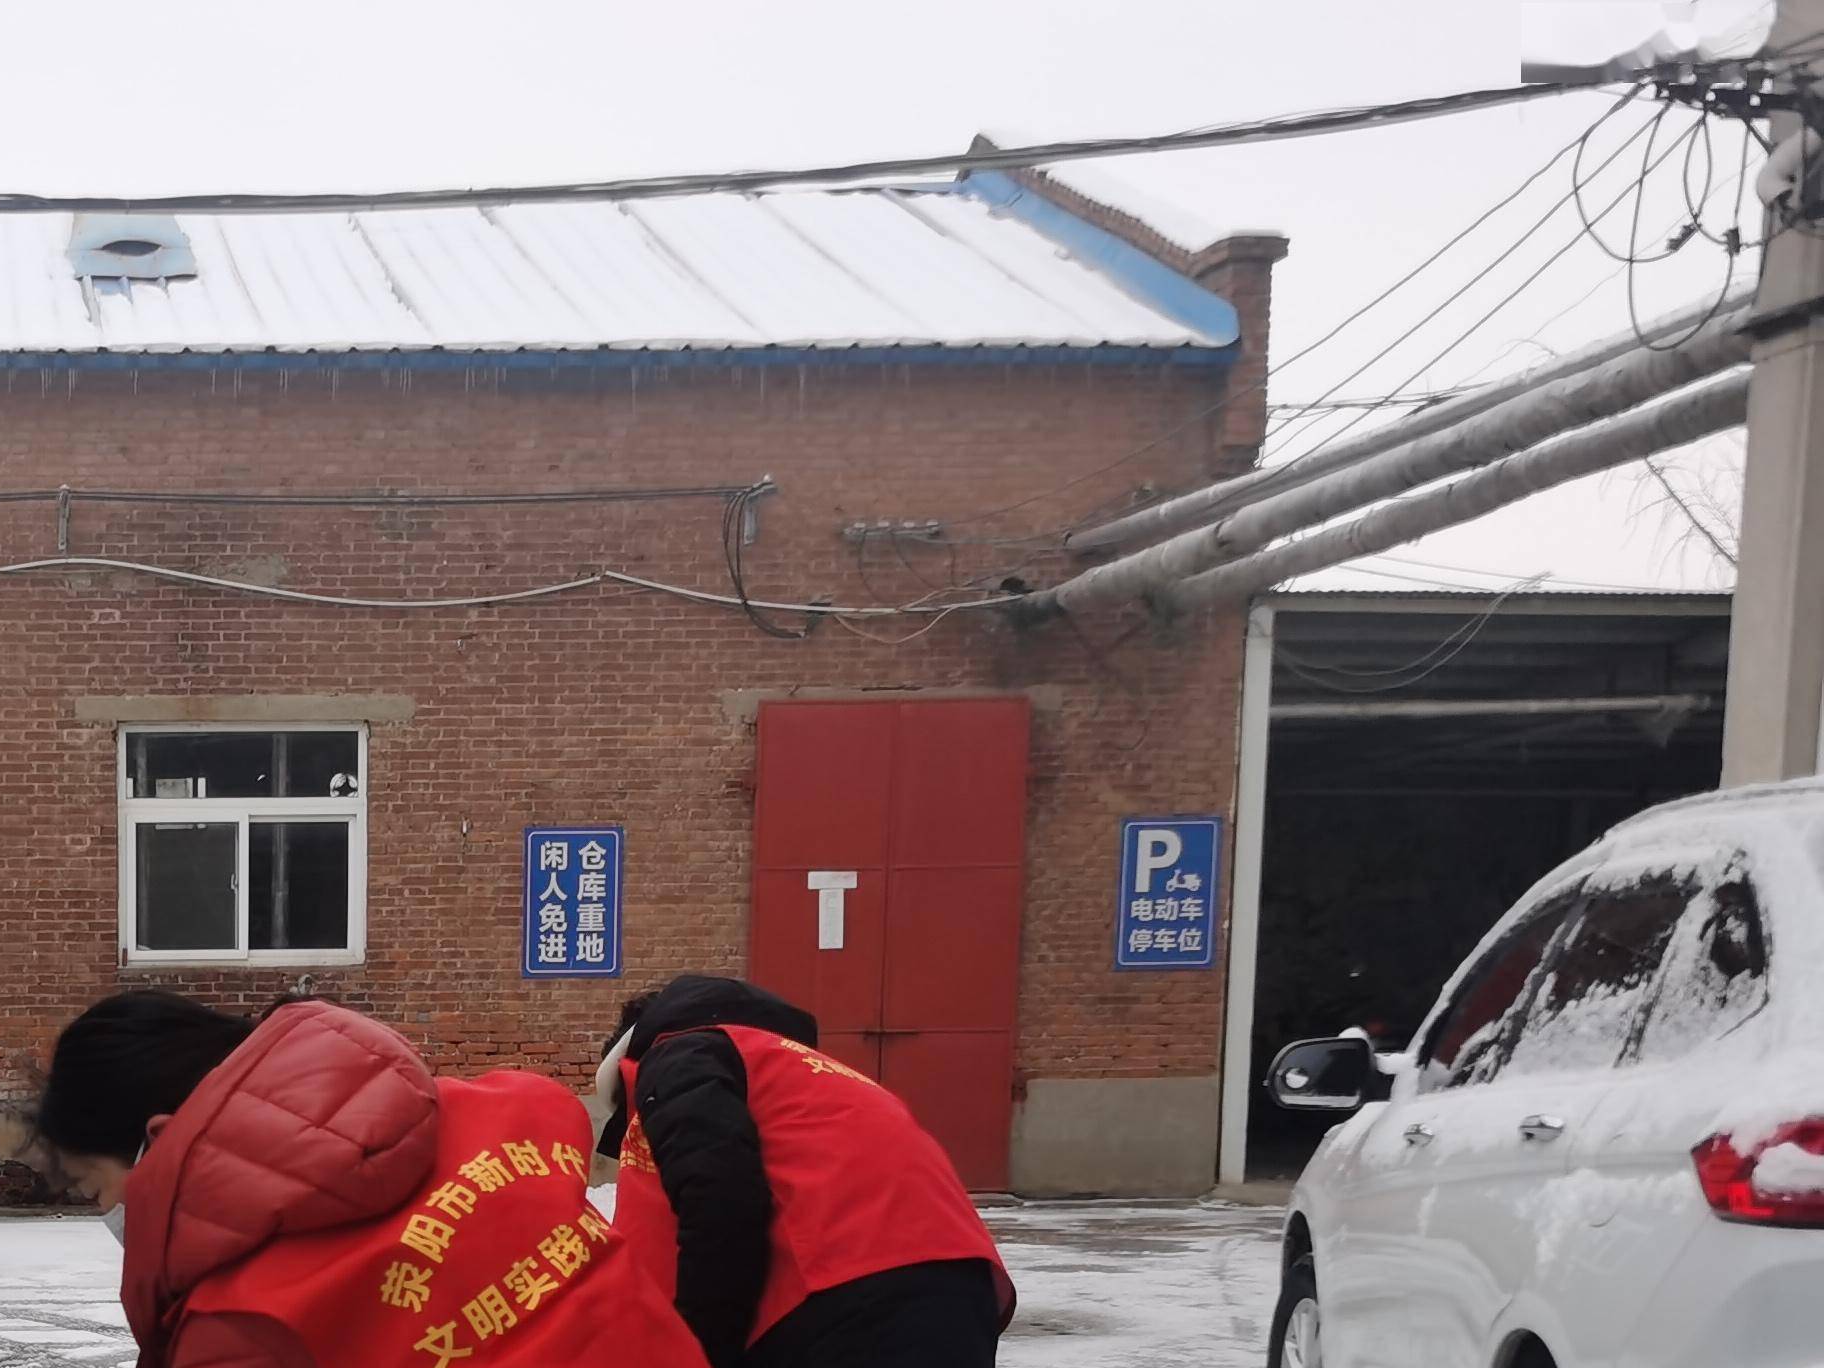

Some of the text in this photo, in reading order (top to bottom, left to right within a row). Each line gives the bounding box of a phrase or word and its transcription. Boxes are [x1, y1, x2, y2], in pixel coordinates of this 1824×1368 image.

[1135, 829, 1182, 893] P
[538, 841, 568, 963] 闲人免进
[576, 841, 607, 962] 仓库重地
[1130, 898, 1204, 922] 电动车
[1129, 928, 1202, 953] 停车位
